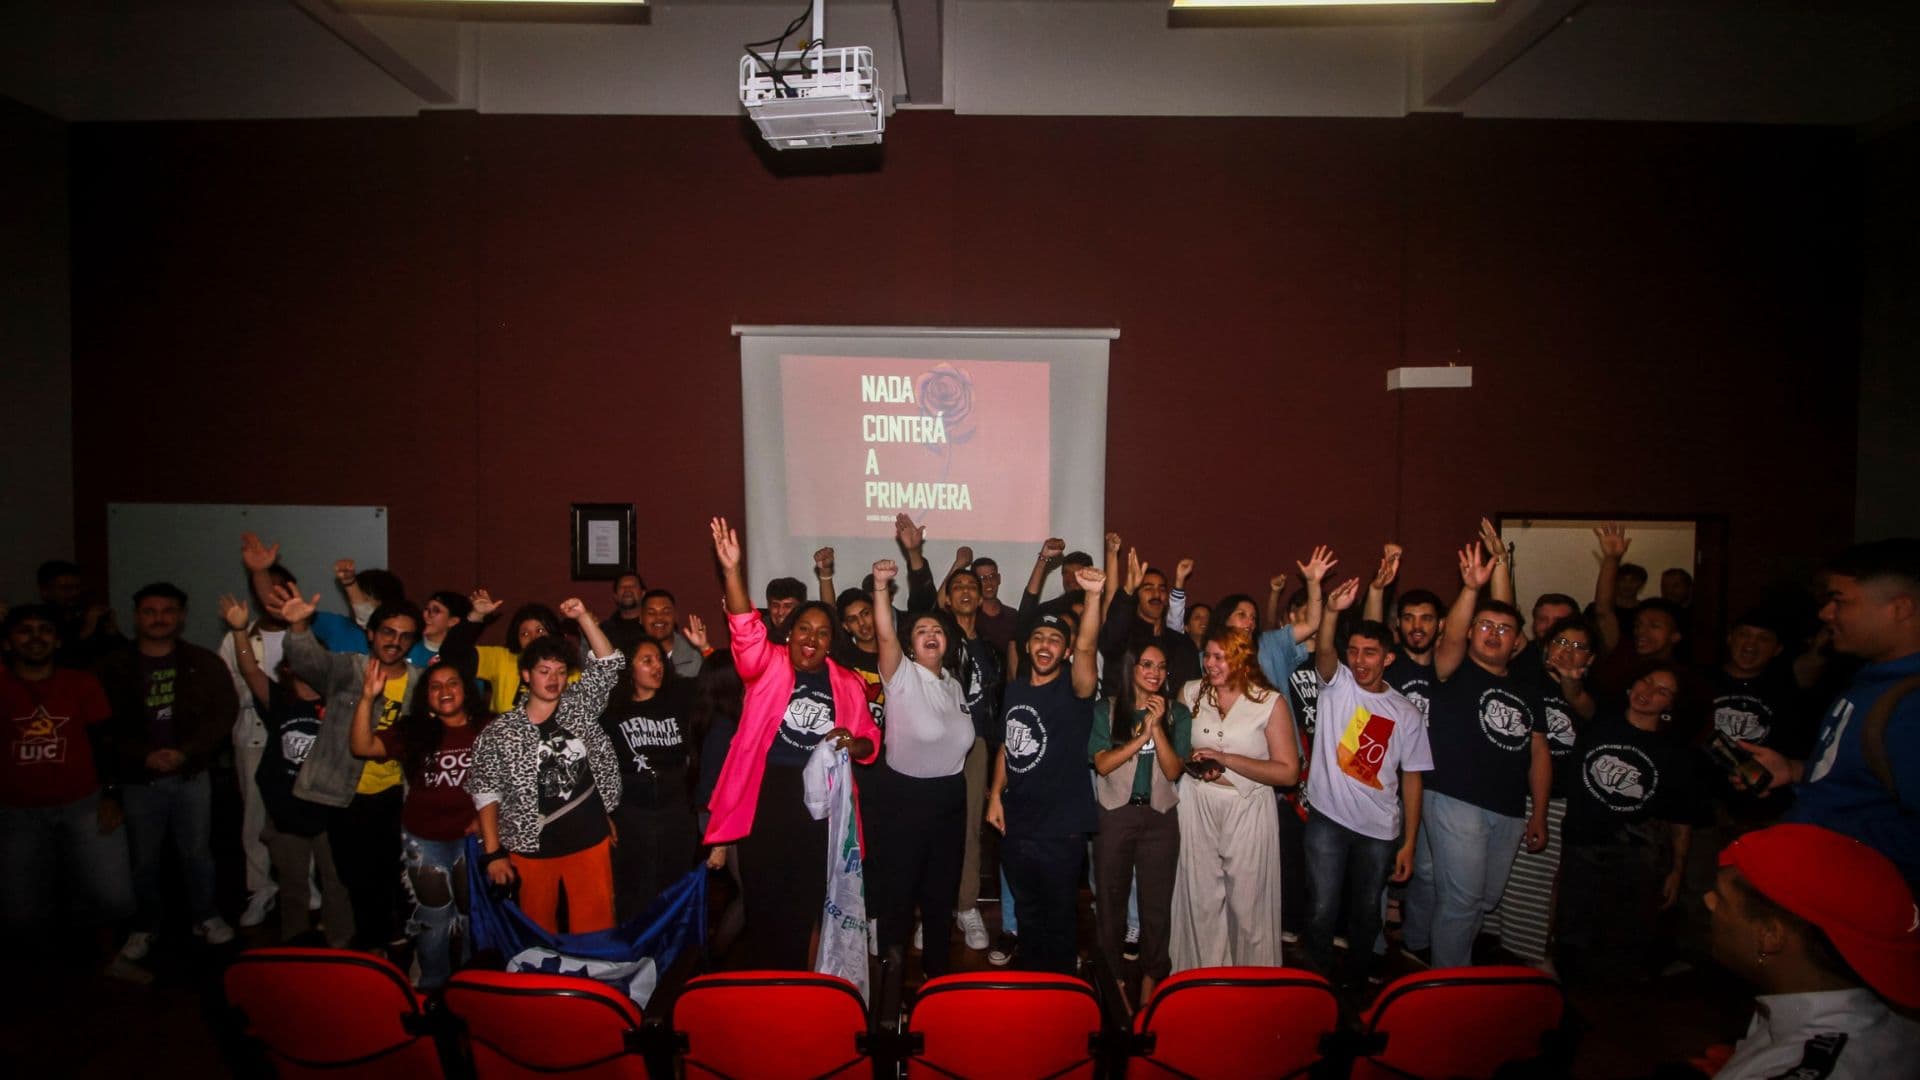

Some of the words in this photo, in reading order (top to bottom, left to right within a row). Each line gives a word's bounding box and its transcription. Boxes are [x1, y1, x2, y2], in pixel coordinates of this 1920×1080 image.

[861, 375, 915, 404] NADA
[863, 411, 947, 444] CONTERÁ
[865, 448, 879, 476] A
[865, 481, 972, 511] PRIMAVERA
[622, 716, 680, 733] LEVANTE
[790, 701, 832, 727] UPE
[19, 743, 58, 761] UJC
[630, 734, 683, 748] JUVENTUDE
[1359, 733, 1385, 764] 70
[1595, 758, 1643, 788] UPE
